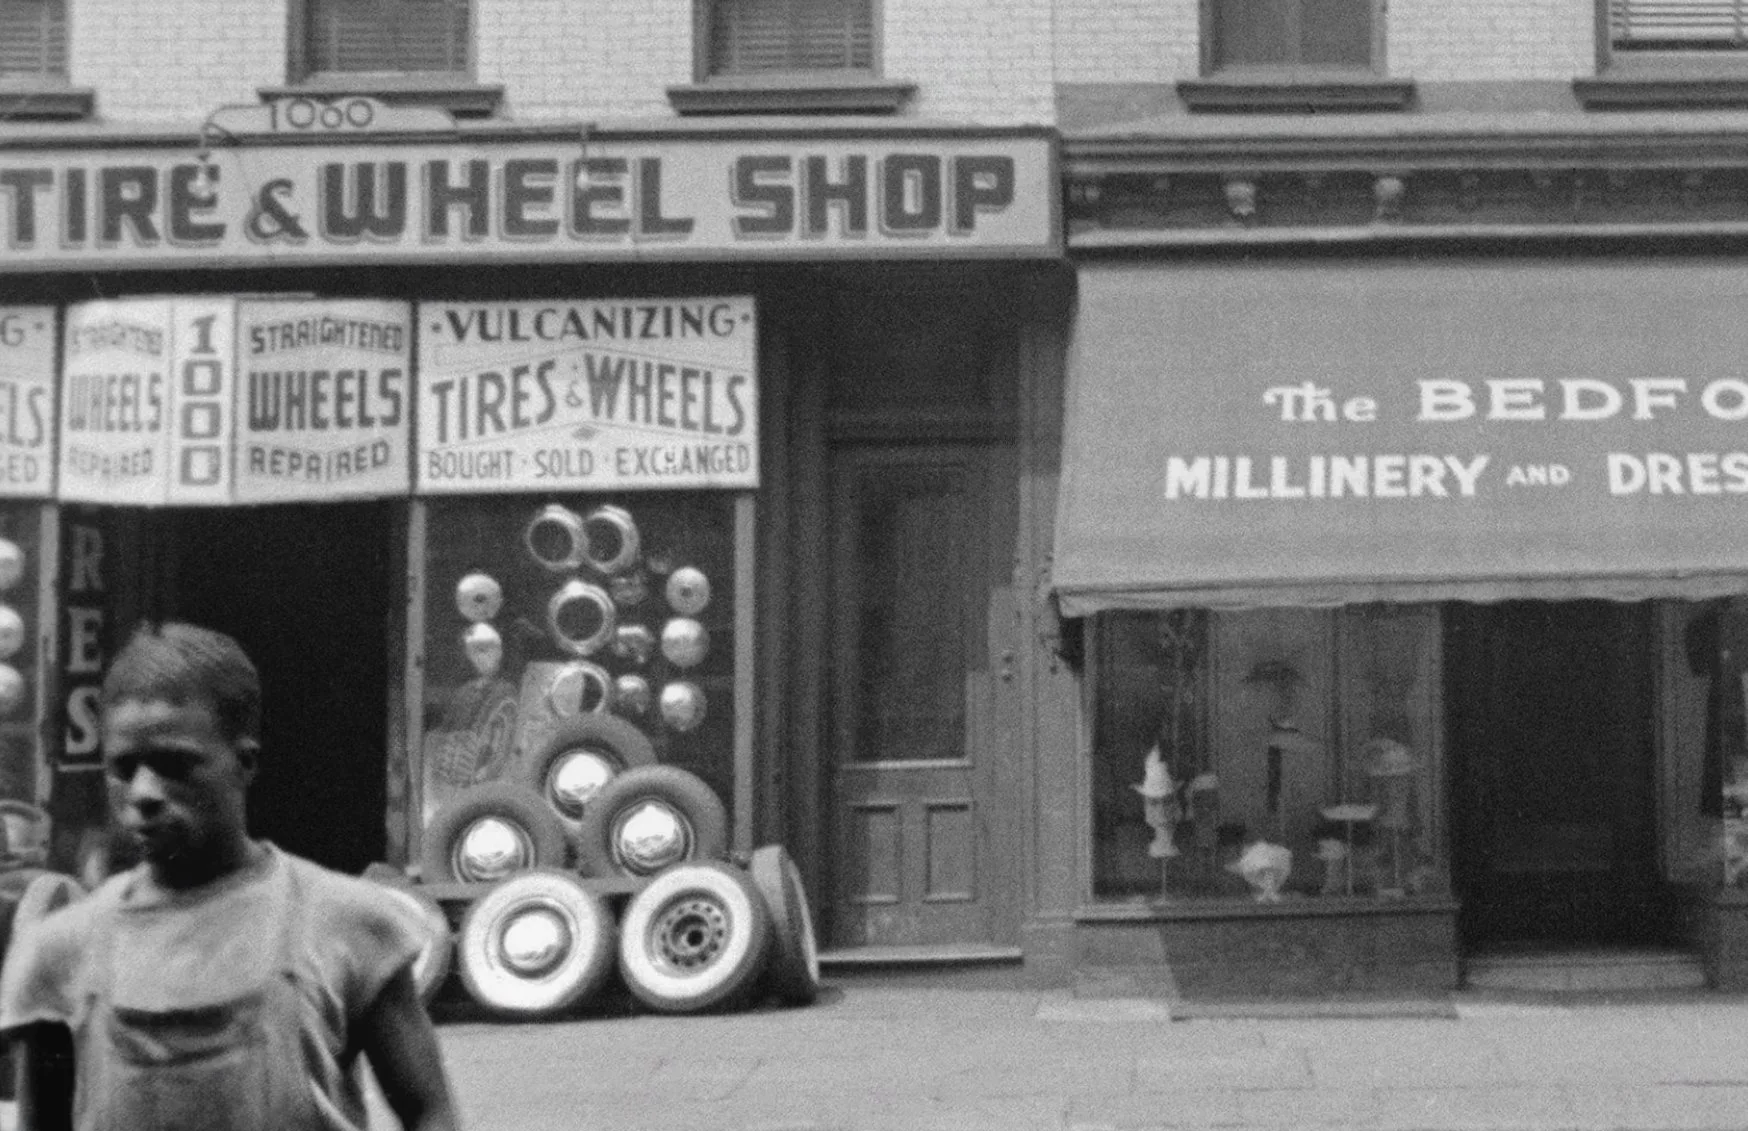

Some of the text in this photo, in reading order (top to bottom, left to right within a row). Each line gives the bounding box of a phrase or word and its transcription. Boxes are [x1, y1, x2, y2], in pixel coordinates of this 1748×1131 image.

[0, 153, 1015, 250] TIRE & WHEEL SHOP
[251, 317, 402, 355] STRAIGHTENED
[446, 303, 735, 342] VULCANIZING
[249, 367, 402, 432] WHEELS
[431, 358, 556, 443] TIRES
[584, 353, 745, 436] WHEELS
[1263, 377, 1748, 422] The BEDFO
[250, 440, 390, 482] REPAIRED
[427, 444, 749, 480] BOUGHT SOLD EXCHANGED
[1165, 452, 1748, 500] MILLINERY AND DRES
[66, 503, 104, 755] RES
